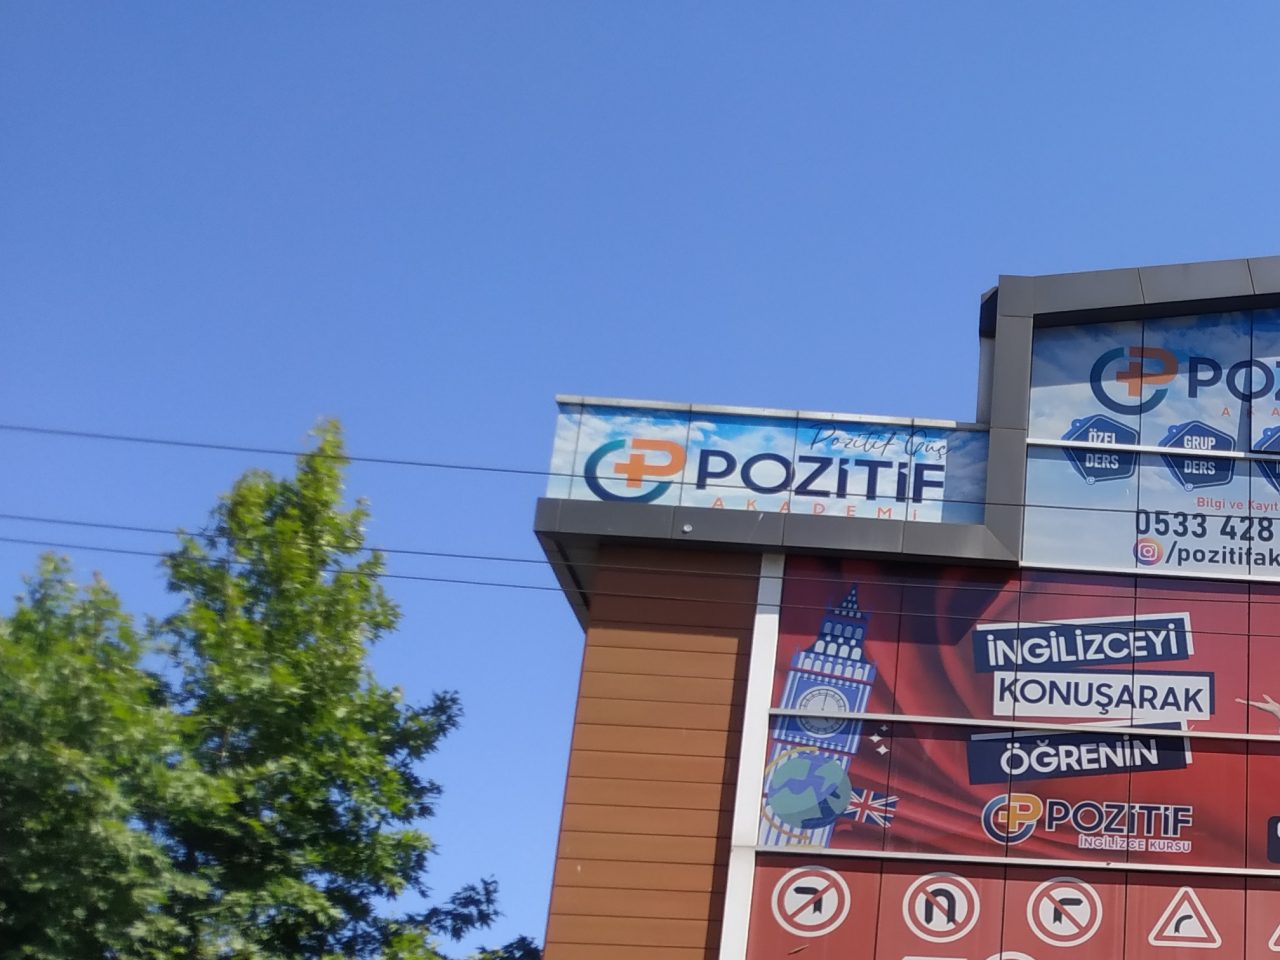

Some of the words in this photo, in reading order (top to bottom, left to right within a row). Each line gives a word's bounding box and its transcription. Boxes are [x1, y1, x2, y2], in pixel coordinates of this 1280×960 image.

[1183, 435, 1216, 450] GRUP
[1085, 453, 1119, 469] DERS
[1184, 460, 1216, 475] DERS
[1196, 496, 1226, 510] Bilgi
[1229, 501, 1244, 509] ve
[1247, 500, 1278, 513] Kayıt
[1135, 508, 1208, 538] 0533
[1219, 515, 1274, 542] 428
[987, 622, 1180, 668] İNGİLİZCEYİ
[998, 677, 1205, 715] KONUŞARAK
[1000, 734, 1159, 776] ÖĞRENİN
[1148, 839, 1192, 853] KURSU
